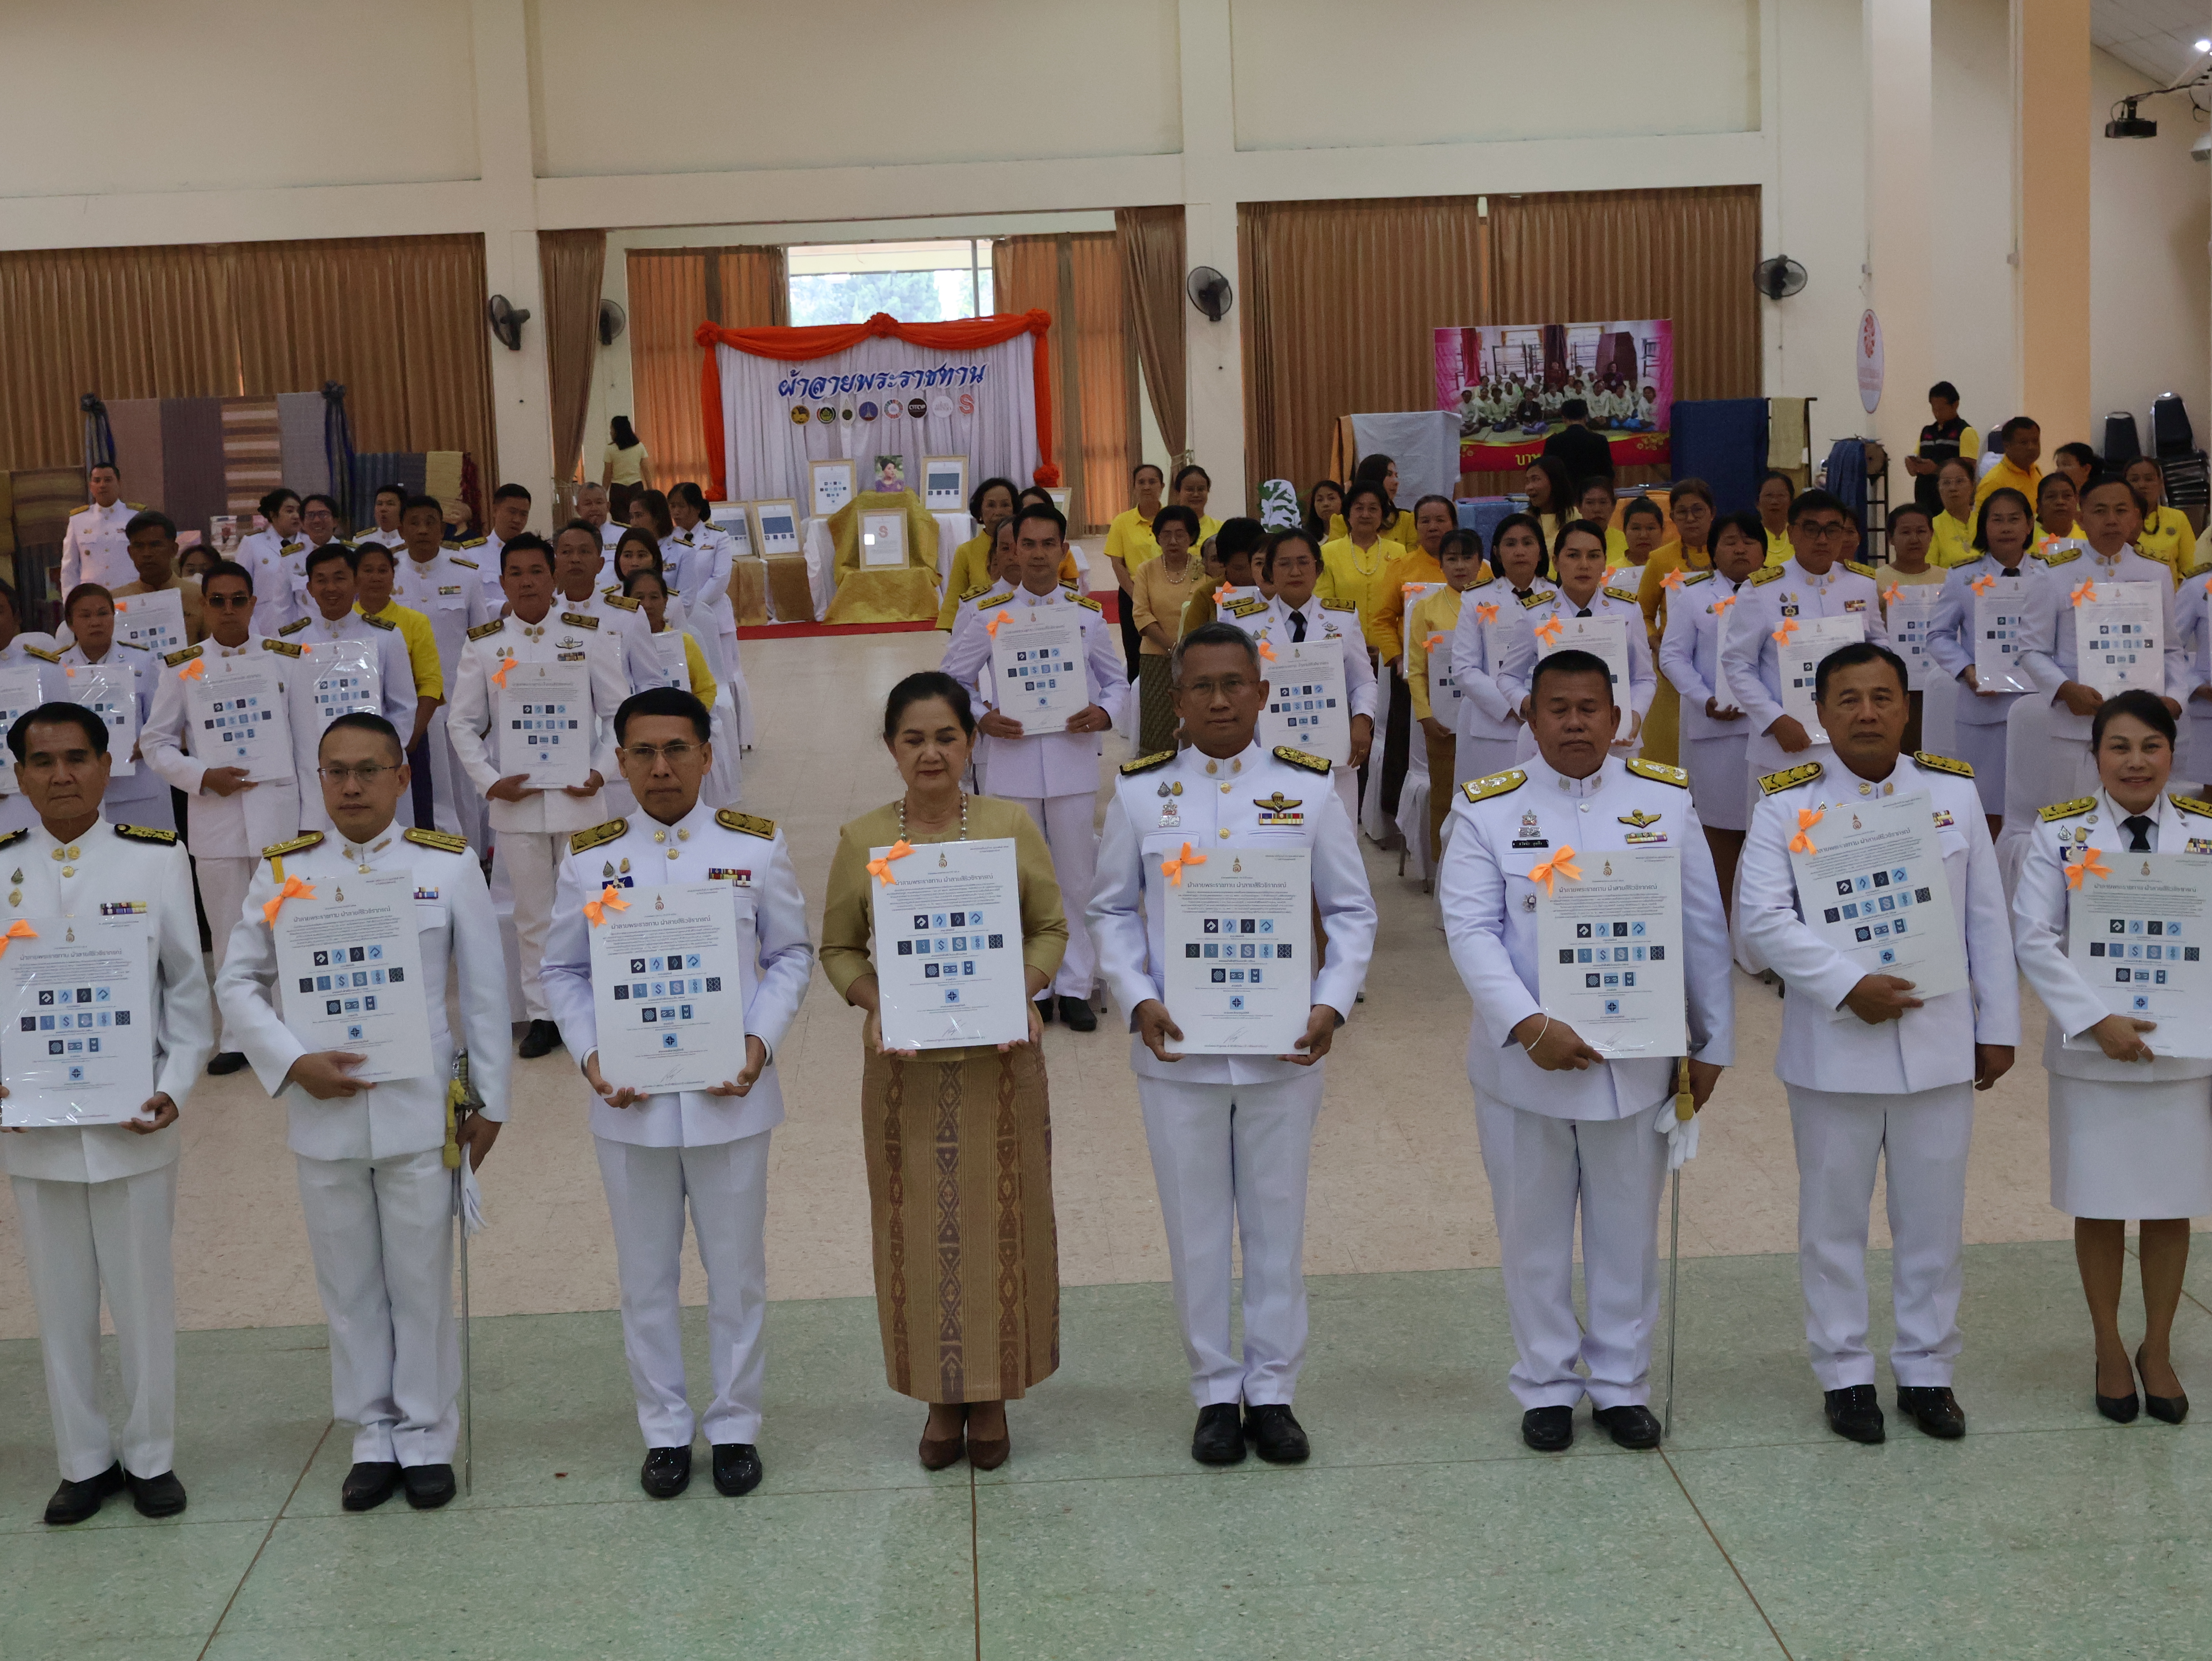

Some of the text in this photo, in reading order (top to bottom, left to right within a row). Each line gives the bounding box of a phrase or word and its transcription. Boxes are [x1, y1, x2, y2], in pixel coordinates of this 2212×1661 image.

[778, 361, 987, 400] ผ้าลายพระราชทาน
